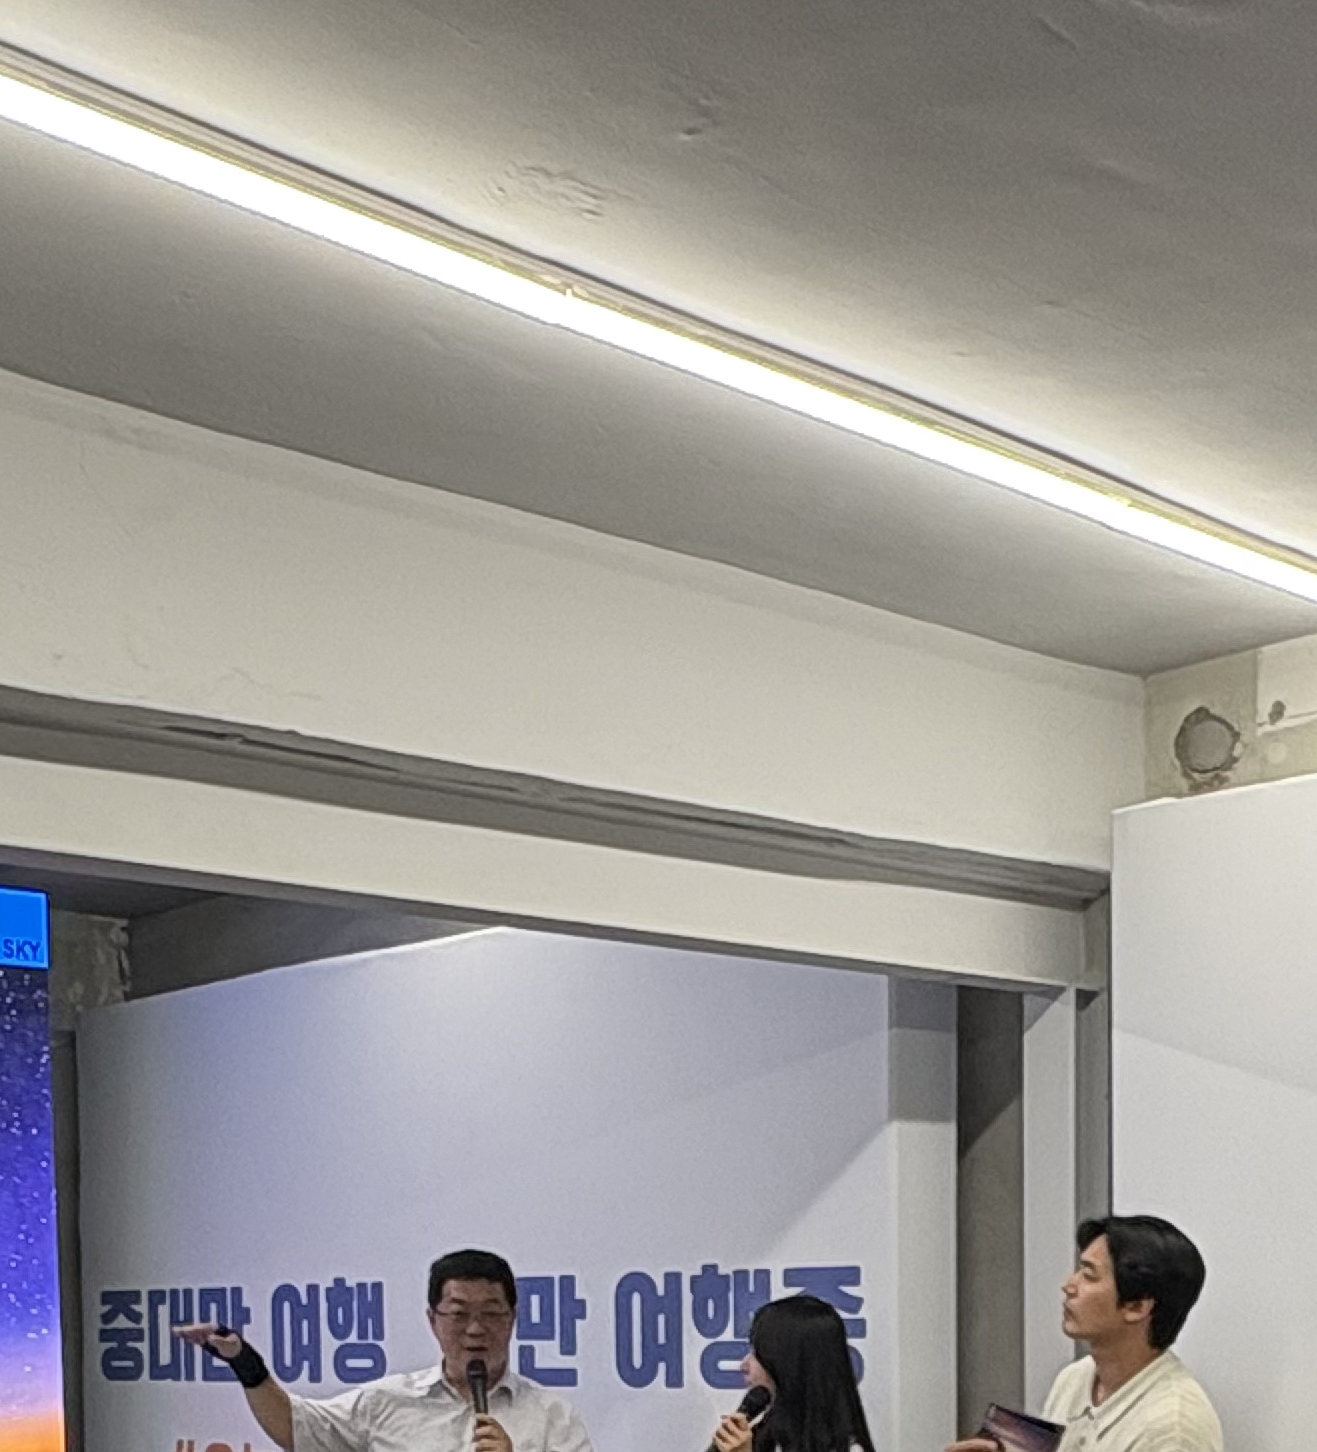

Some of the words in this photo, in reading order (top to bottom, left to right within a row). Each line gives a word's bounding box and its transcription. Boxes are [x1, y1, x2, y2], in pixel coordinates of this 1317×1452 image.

[3, 938, 41, 962] SKY
[99, 1287, 251, 1382] 중대만
[272, 1277, 387, 1384] 여행
